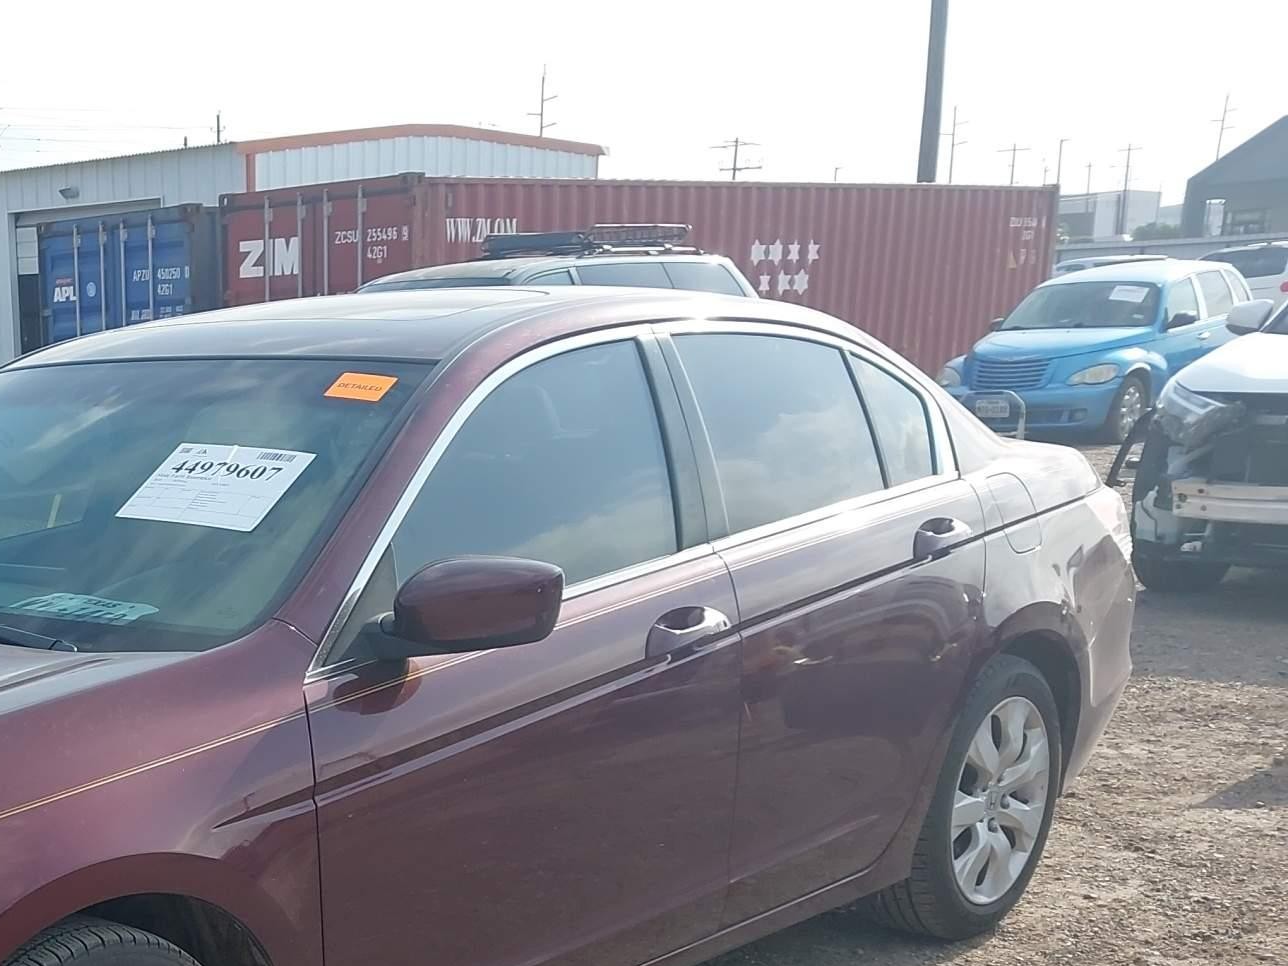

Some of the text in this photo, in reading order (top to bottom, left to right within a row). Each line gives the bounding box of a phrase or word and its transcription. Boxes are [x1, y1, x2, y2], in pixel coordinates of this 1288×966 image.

[334, 231, 359, 244] ZCSU
[367, 226, 398, 242] 255496
[239, 236, 300, 279] ZIM
[367, 245, 387, 259] 42G1
[132, 269, 152, 282] APZU
[53, 286, 79, 303] APL
[336, 382, 383, 392] DETAILED
[171, 459, 284, 481] 44979607
